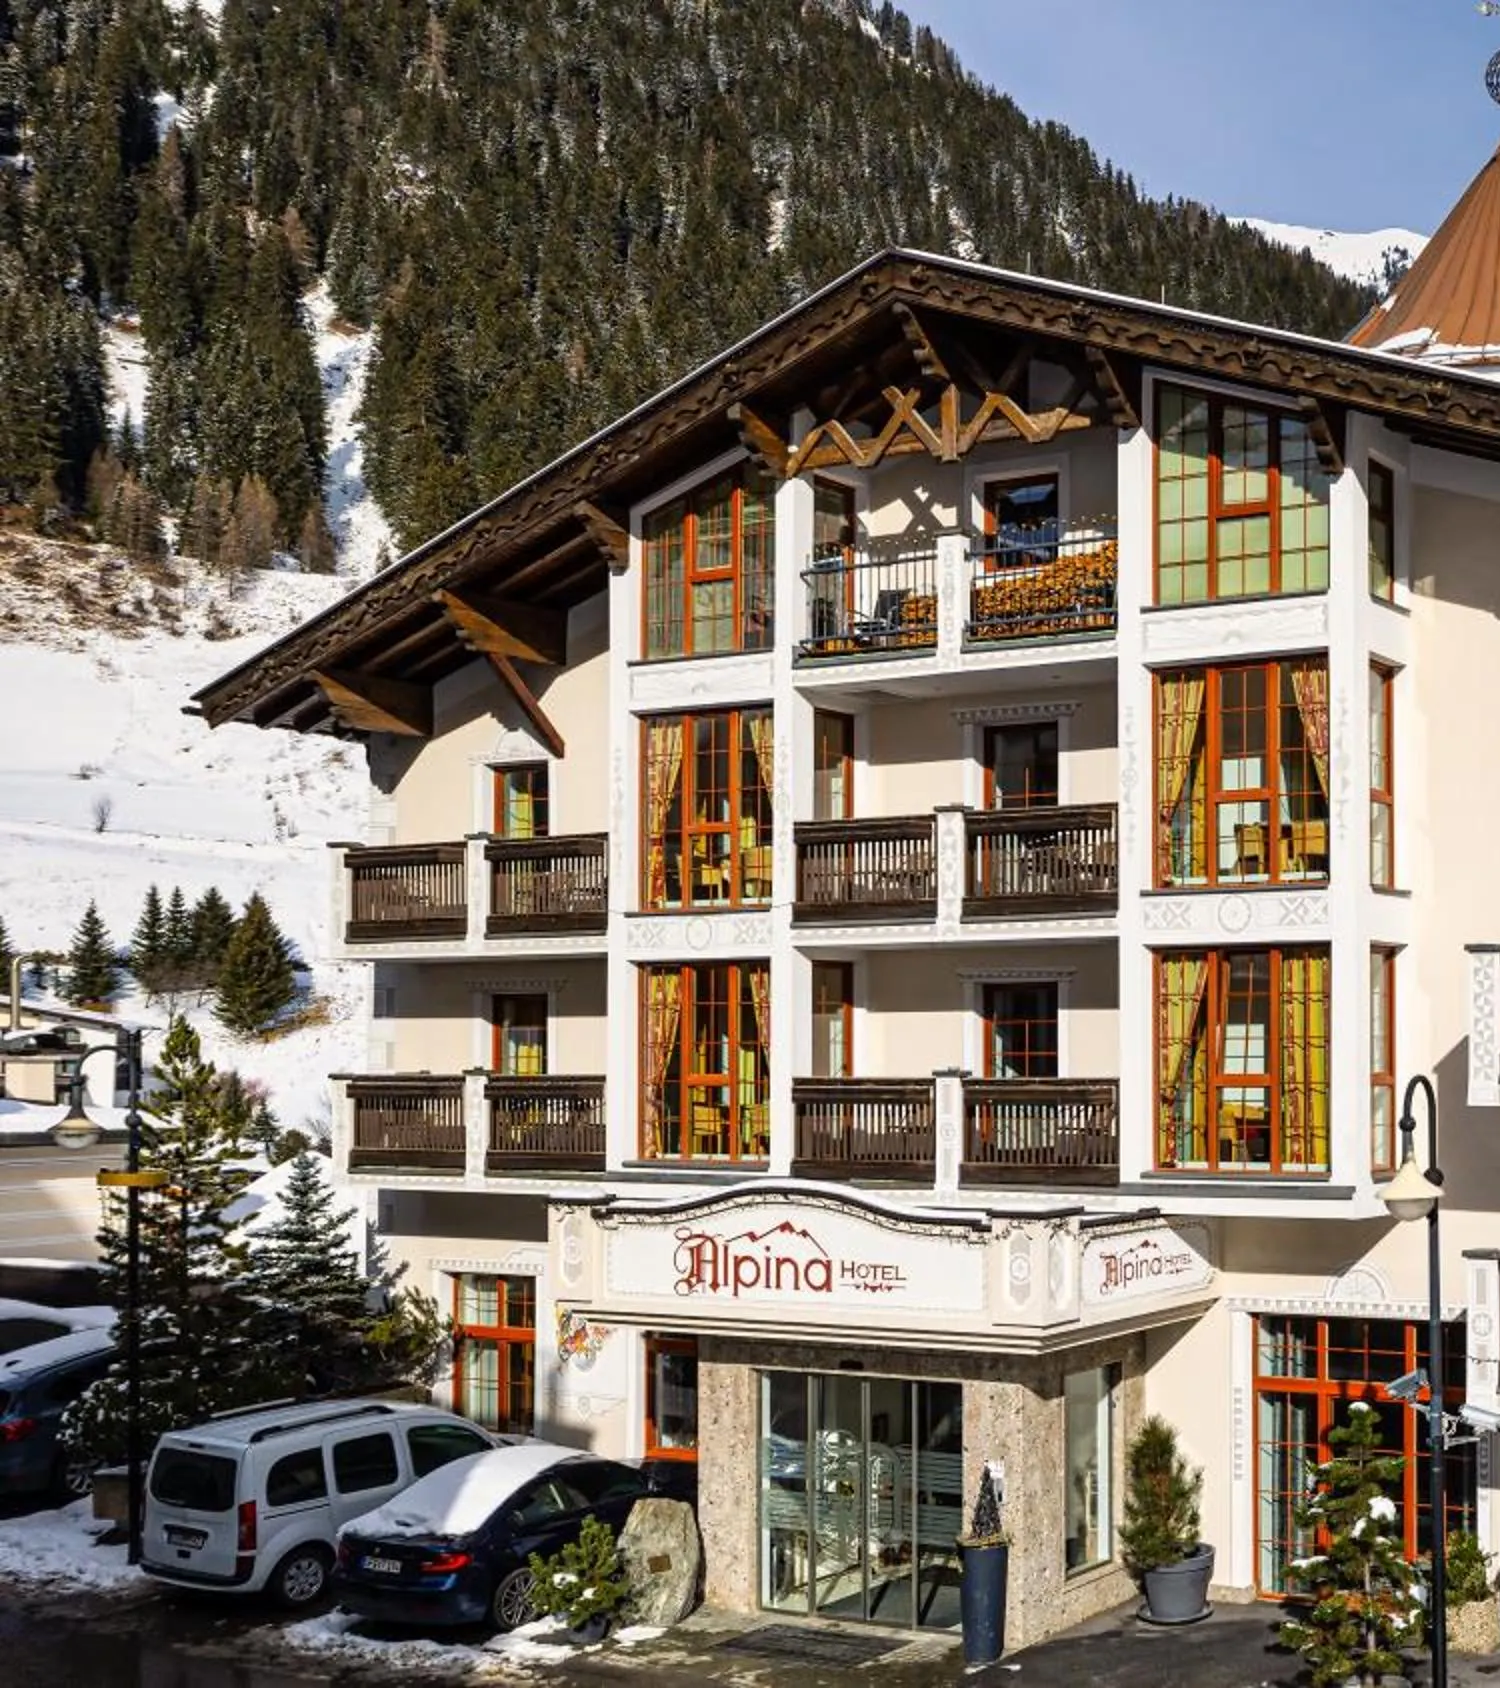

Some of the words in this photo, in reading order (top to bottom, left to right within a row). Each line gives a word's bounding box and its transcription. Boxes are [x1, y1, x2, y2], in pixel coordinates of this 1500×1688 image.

[674, 1227, 833, 1297] Alpina
[840, 1260, 907, 1282] HOTEL
[1100, 1253, 1163, 1296] Alpina
[1163, 1252, 1193, 1269] HOTEL
